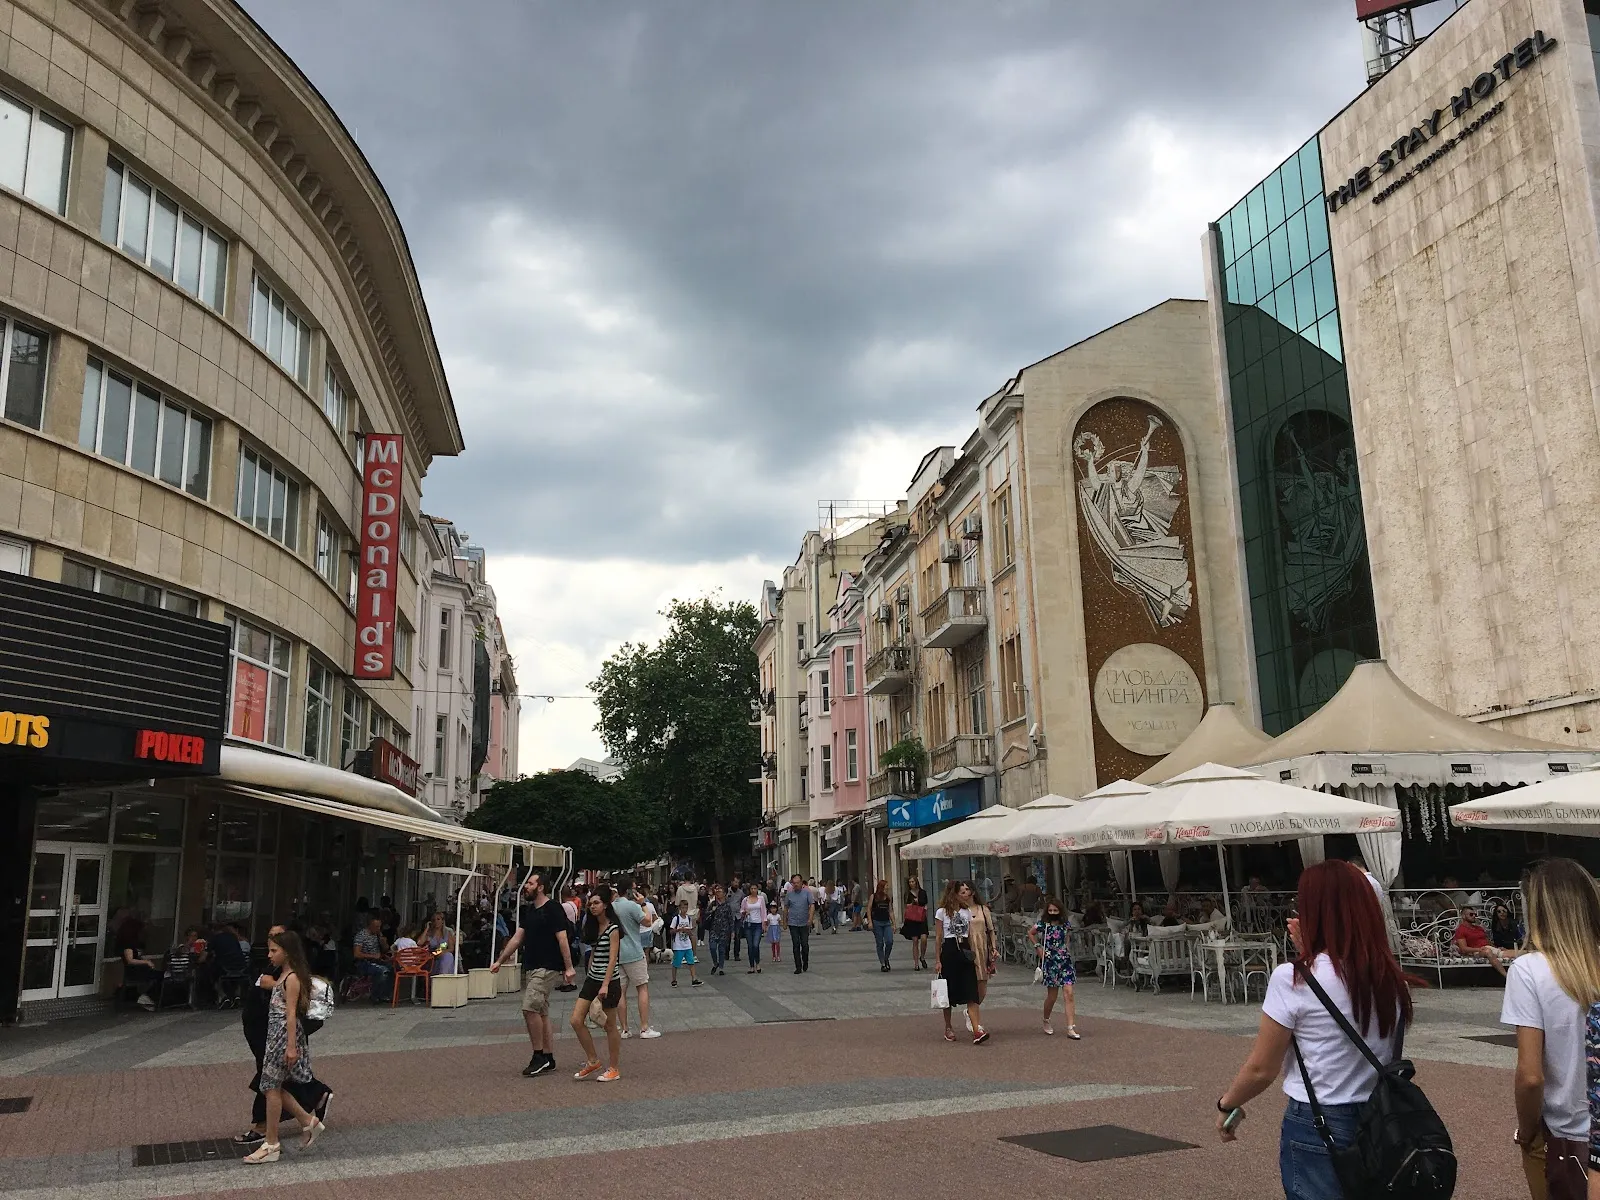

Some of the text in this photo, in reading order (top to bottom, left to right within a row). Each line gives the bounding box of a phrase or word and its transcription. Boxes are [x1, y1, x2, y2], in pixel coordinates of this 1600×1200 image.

[1326, 30, 1557, 212] THE STAY HOTEL
[360, 440, 399, 672] McDonald's
[1105, 669, 1189, 686] ПЛОВДИВ
[1101, 688, 1200, 704] ЛЕНИНГРАД
[0, 711, 50, 748] OTS
[136, 729, 205, 765] POKER
[1289, 818, 1341, 829] БЪЛГАРИЯ
